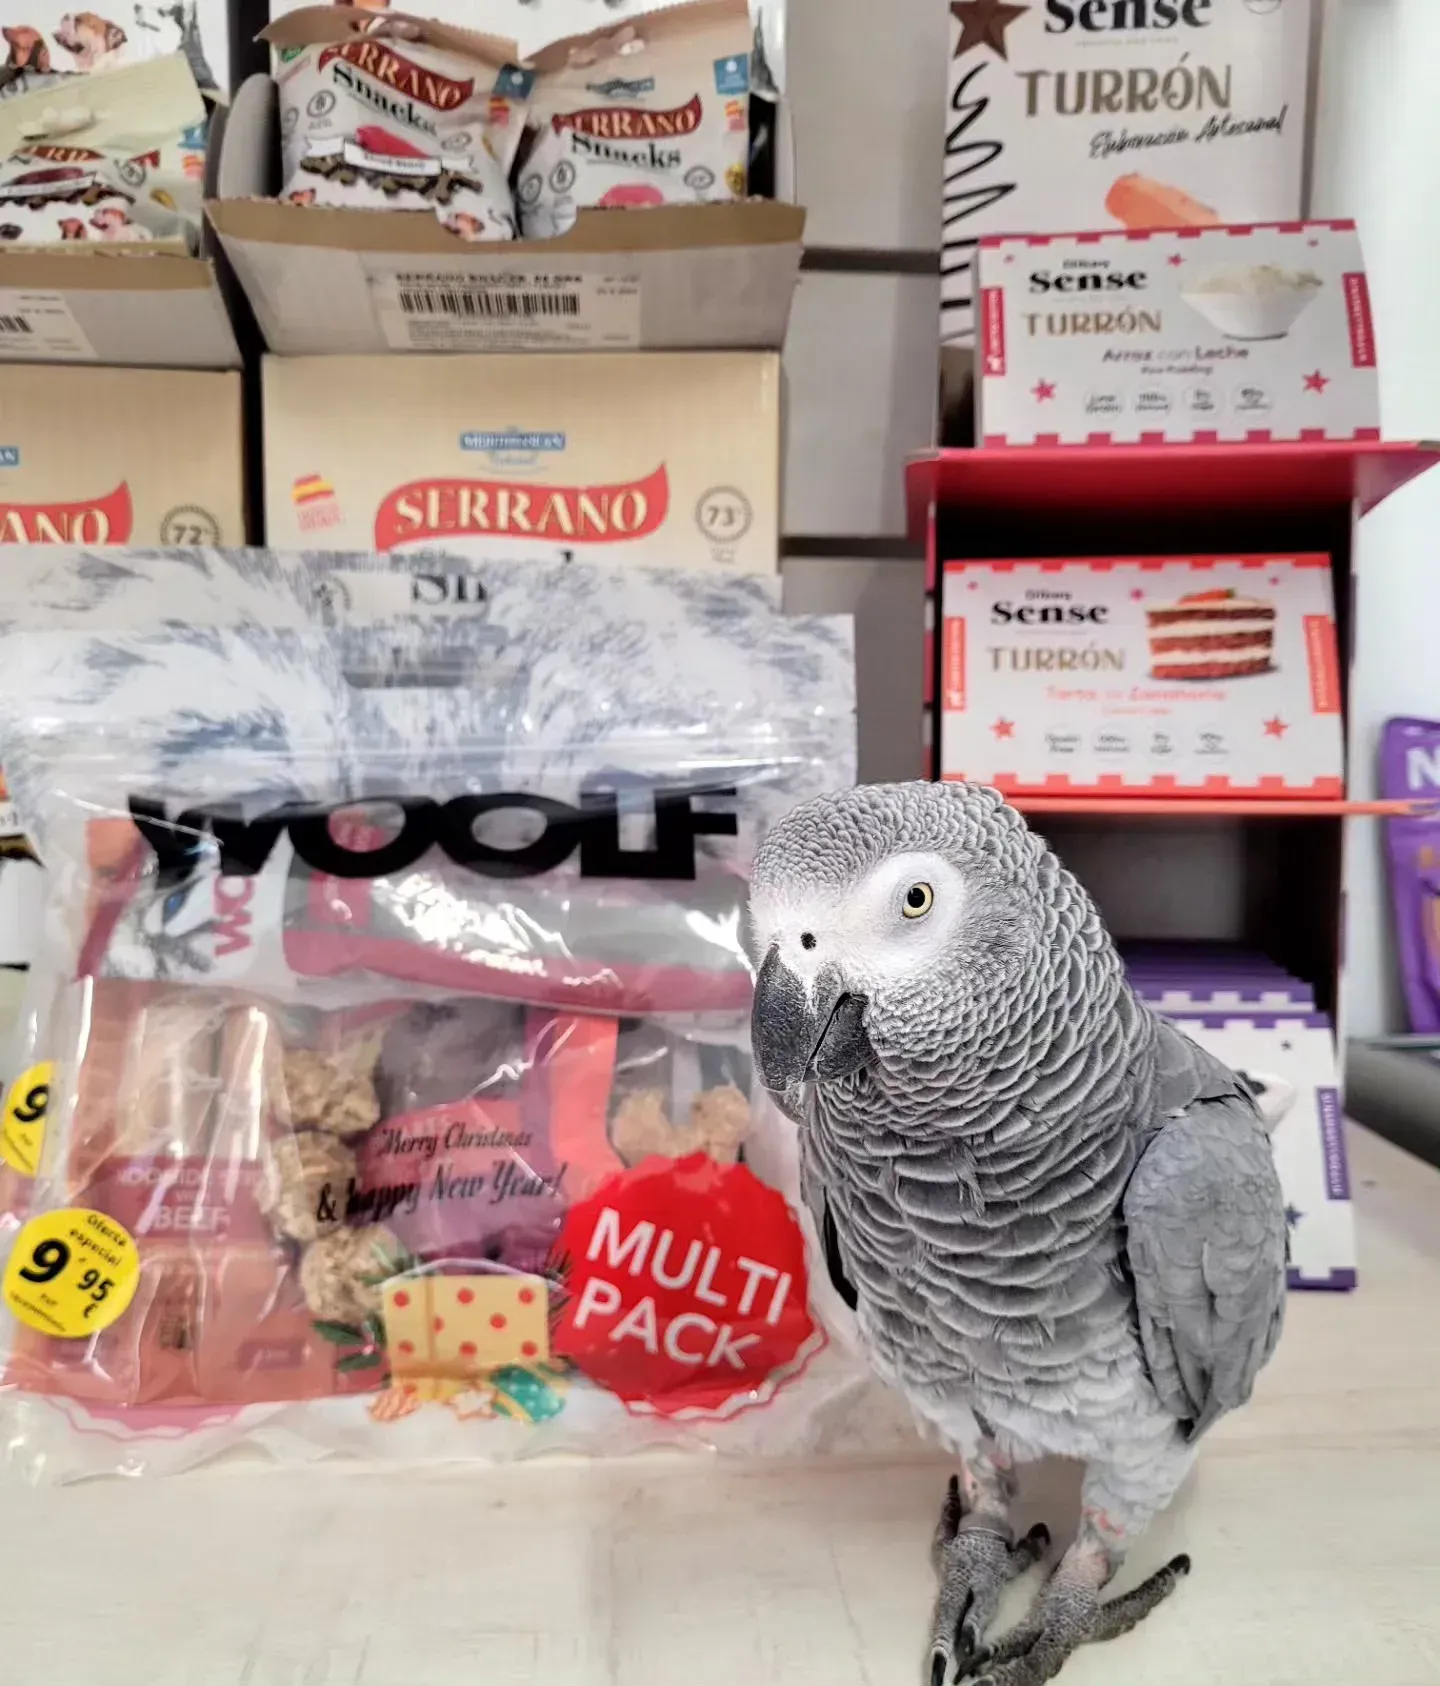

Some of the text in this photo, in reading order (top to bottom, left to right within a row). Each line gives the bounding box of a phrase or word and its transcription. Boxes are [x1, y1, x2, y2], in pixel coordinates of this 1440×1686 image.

[1044, 0, 1212, 34] Sense
[1015, 51, 1233, 118] TURRÓN
[573, 108, 697, 138] ERRANO
[571, 131, 682, 170] Snacks
[1028, 269, 1148, 294] Sense
[1020, 303, 1163, 338] TURRÓN
[394, 485, 648, 536] SERRANO
[990, 600, 1109, 626] Sense
[986, 640, 1126, 672] TURRÓN
[129, 786, 738, 881] WOOLF
[13, 1084, 50, 1123] 9
[375, 1121, 534, 1159] Merry Christmas
[316, 1182, 338, 1223] &
[430, 1163, 484, 1201] New
[69, 1227, 122, 1268] especial
[86, 1213, 127, 1248] Oferta
[585, 1206, 793, 1327] MULTI
[572, 1276, 764, 1371] PACK
